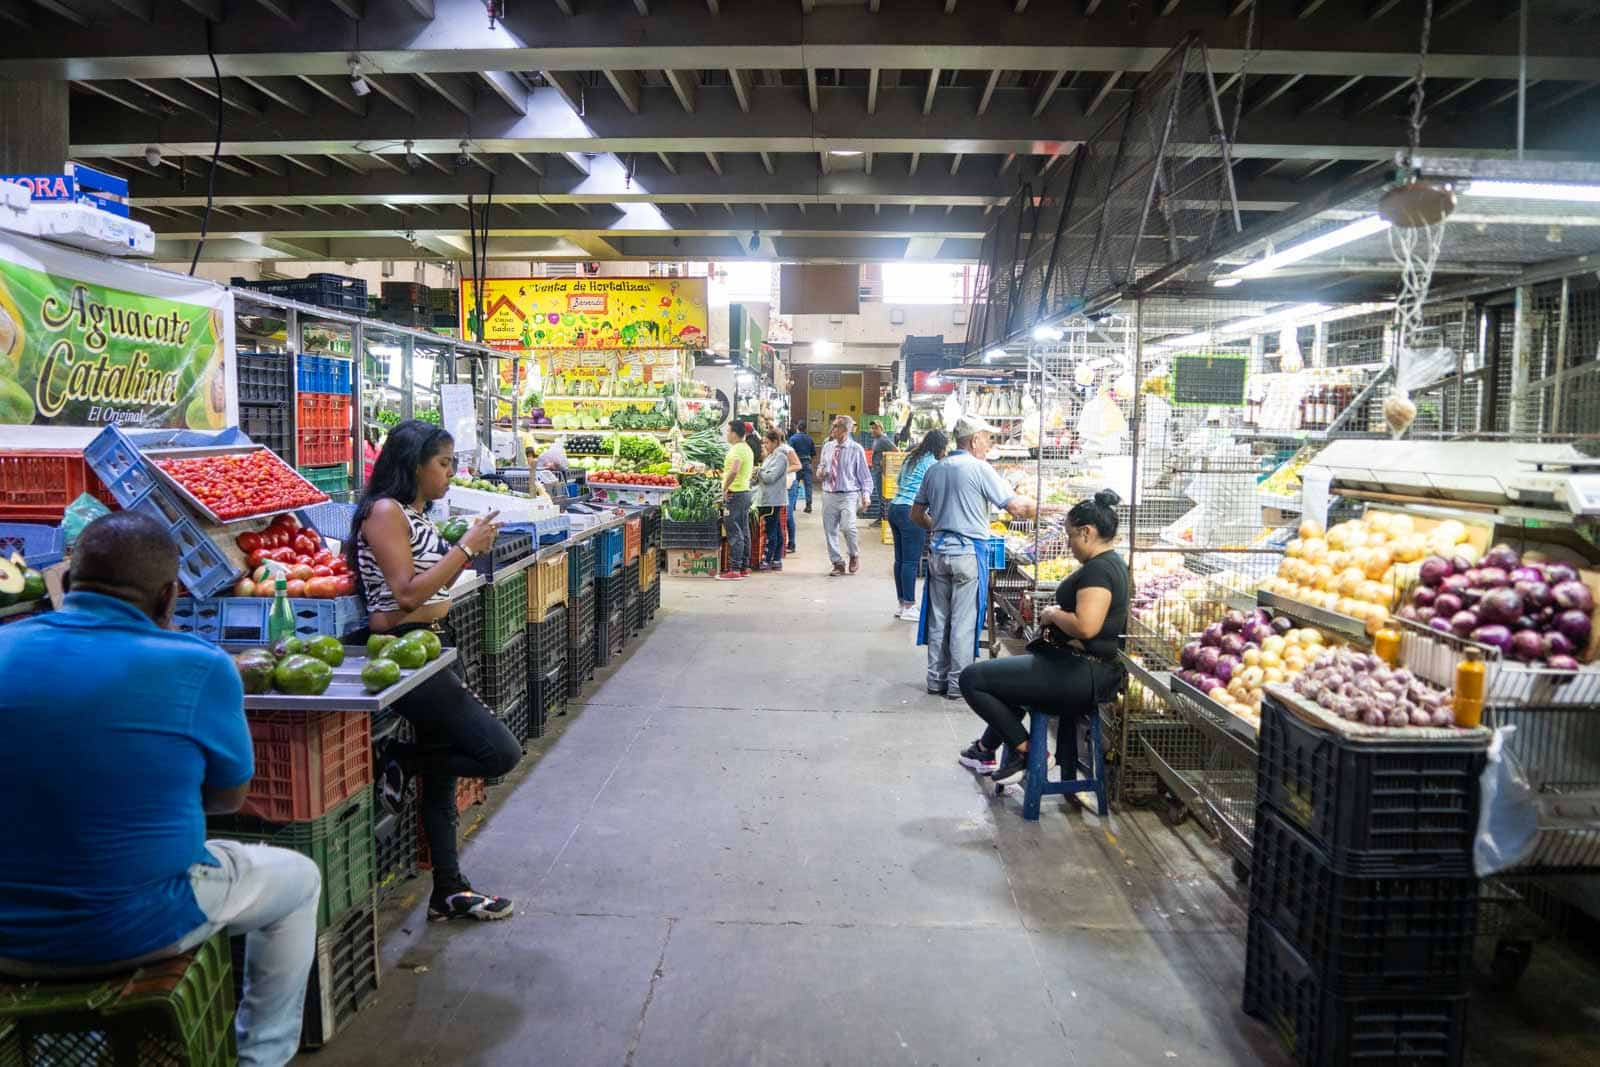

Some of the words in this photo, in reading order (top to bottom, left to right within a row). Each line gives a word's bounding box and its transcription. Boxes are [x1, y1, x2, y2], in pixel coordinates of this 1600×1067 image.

[573, 280, 586, 292] de
[42, 285, 190, 351] Aguacate
[38, 339, 177, 416] Catalina
[88, 406, 101, 421] El
[103, 406, 146, 425] Original
